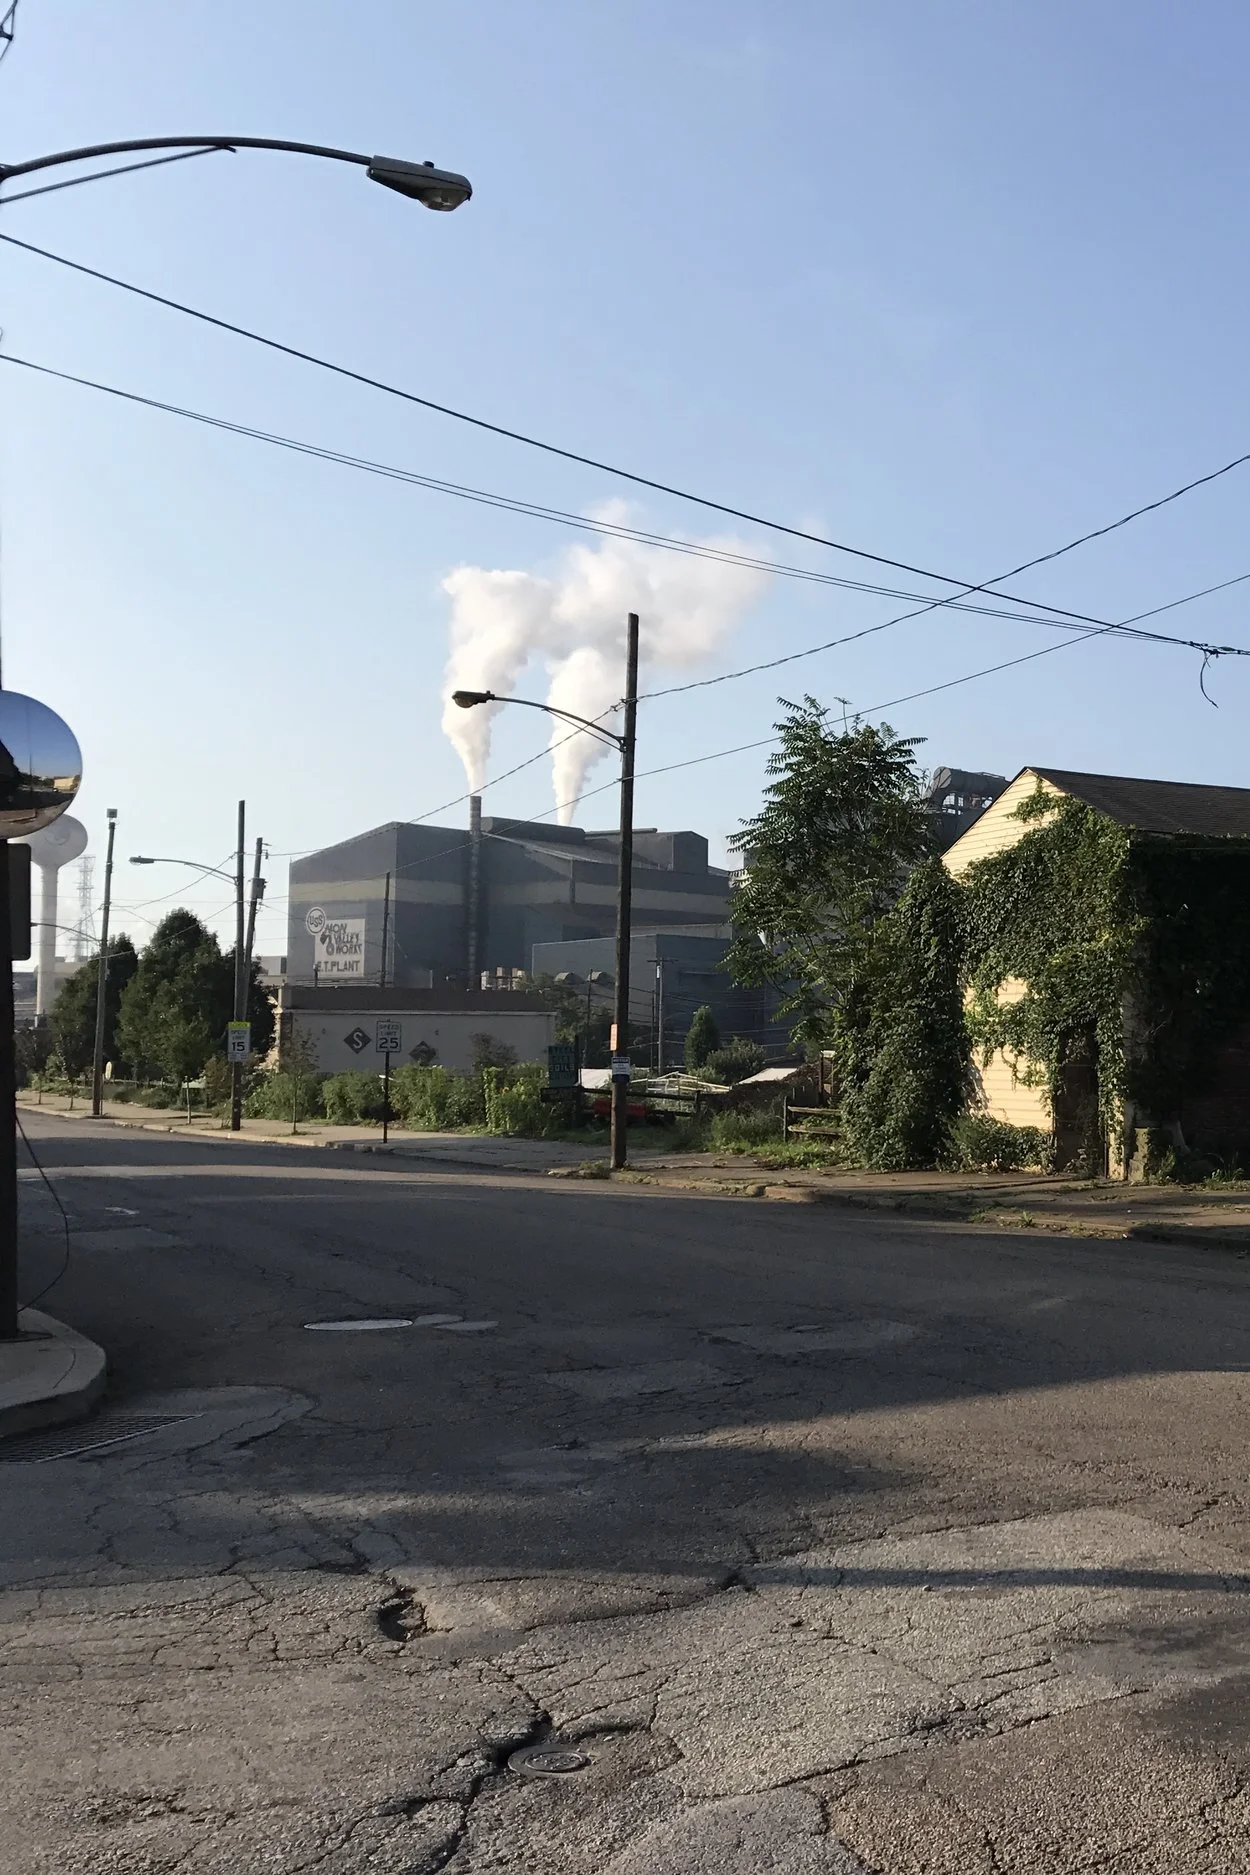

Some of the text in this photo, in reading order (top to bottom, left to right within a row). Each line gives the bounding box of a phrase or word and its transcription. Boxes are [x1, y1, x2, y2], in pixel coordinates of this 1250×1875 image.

[309, 914, 323, 928] USS
[231, 1041, 245, 1052] 15
[379, 1037, 399, 1049] 25
